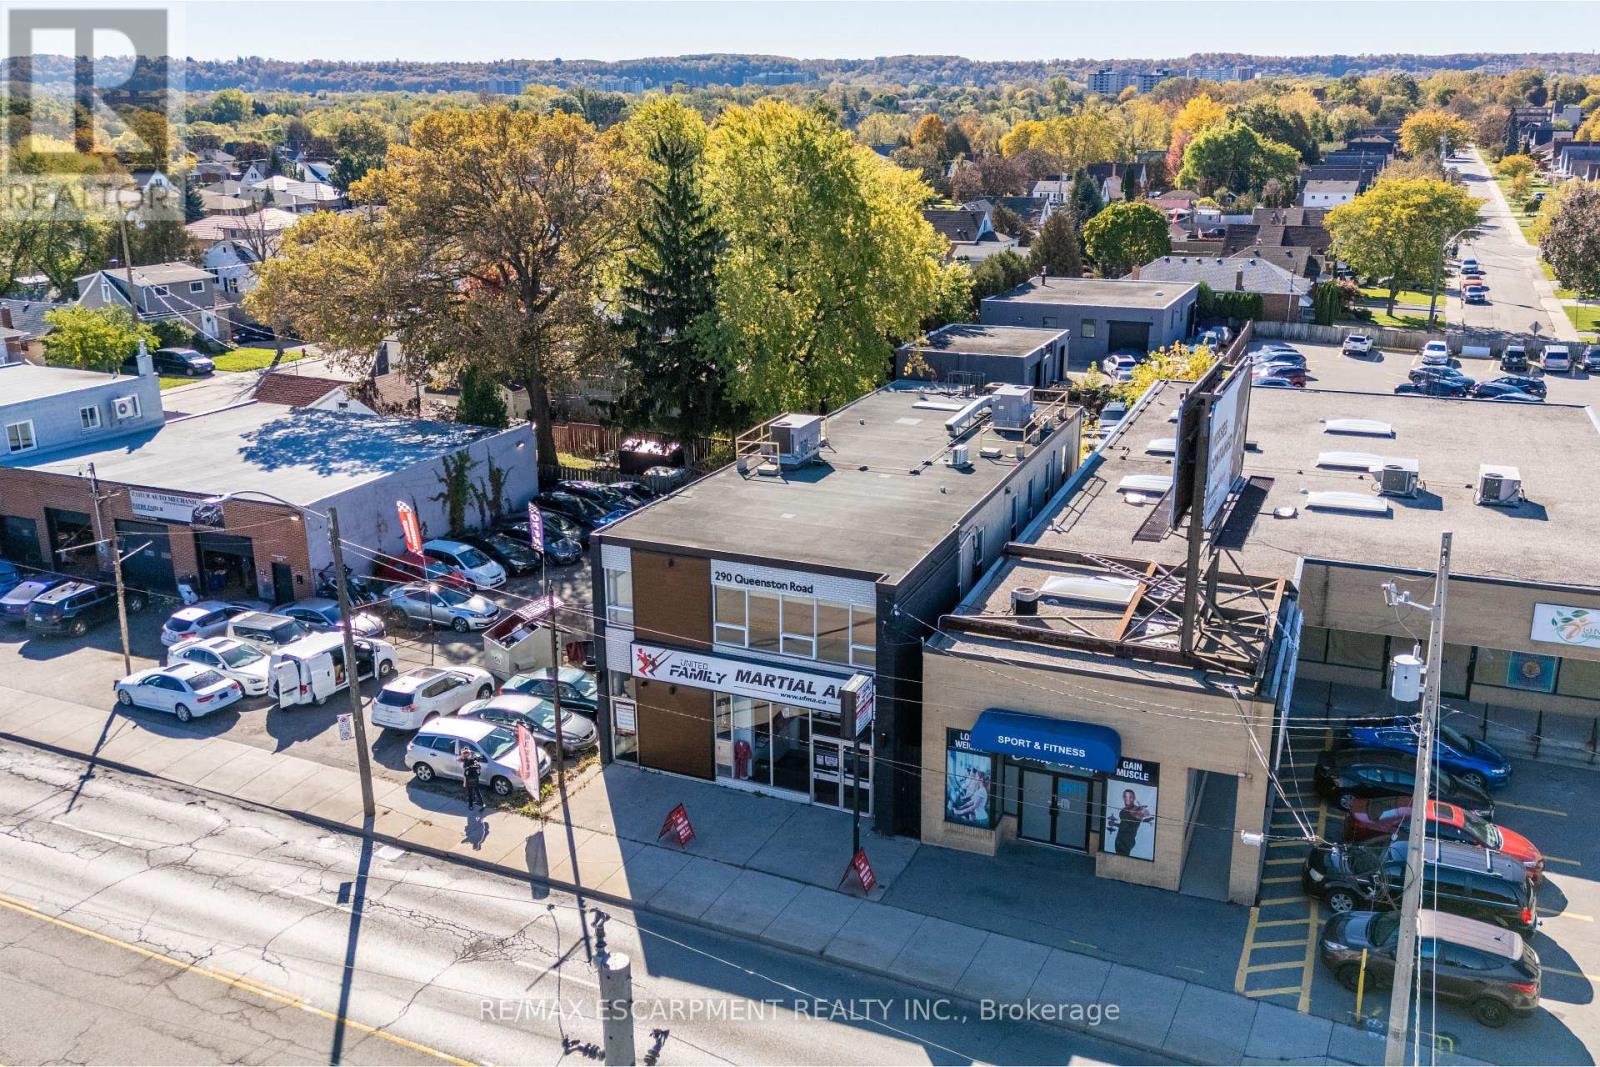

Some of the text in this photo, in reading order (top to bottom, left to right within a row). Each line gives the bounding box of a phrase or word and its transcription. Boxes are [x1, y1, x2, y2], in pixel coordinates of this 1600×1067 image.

[714, 571, 814, 594] 290 Queenston Road
[680, 659, 709, 670] UNITED
[669, 664, 727, 684] FAMILY
[735, 669, 817, 695] MARTIAL
[780, 692, 827, 705] www.ufma.ca
[997, 735, 1086, 758] SPORT & FITNESS
[1122, 760, 1143, 772] GAIN
[1116, 768, 1149, 782] MUSCLE
